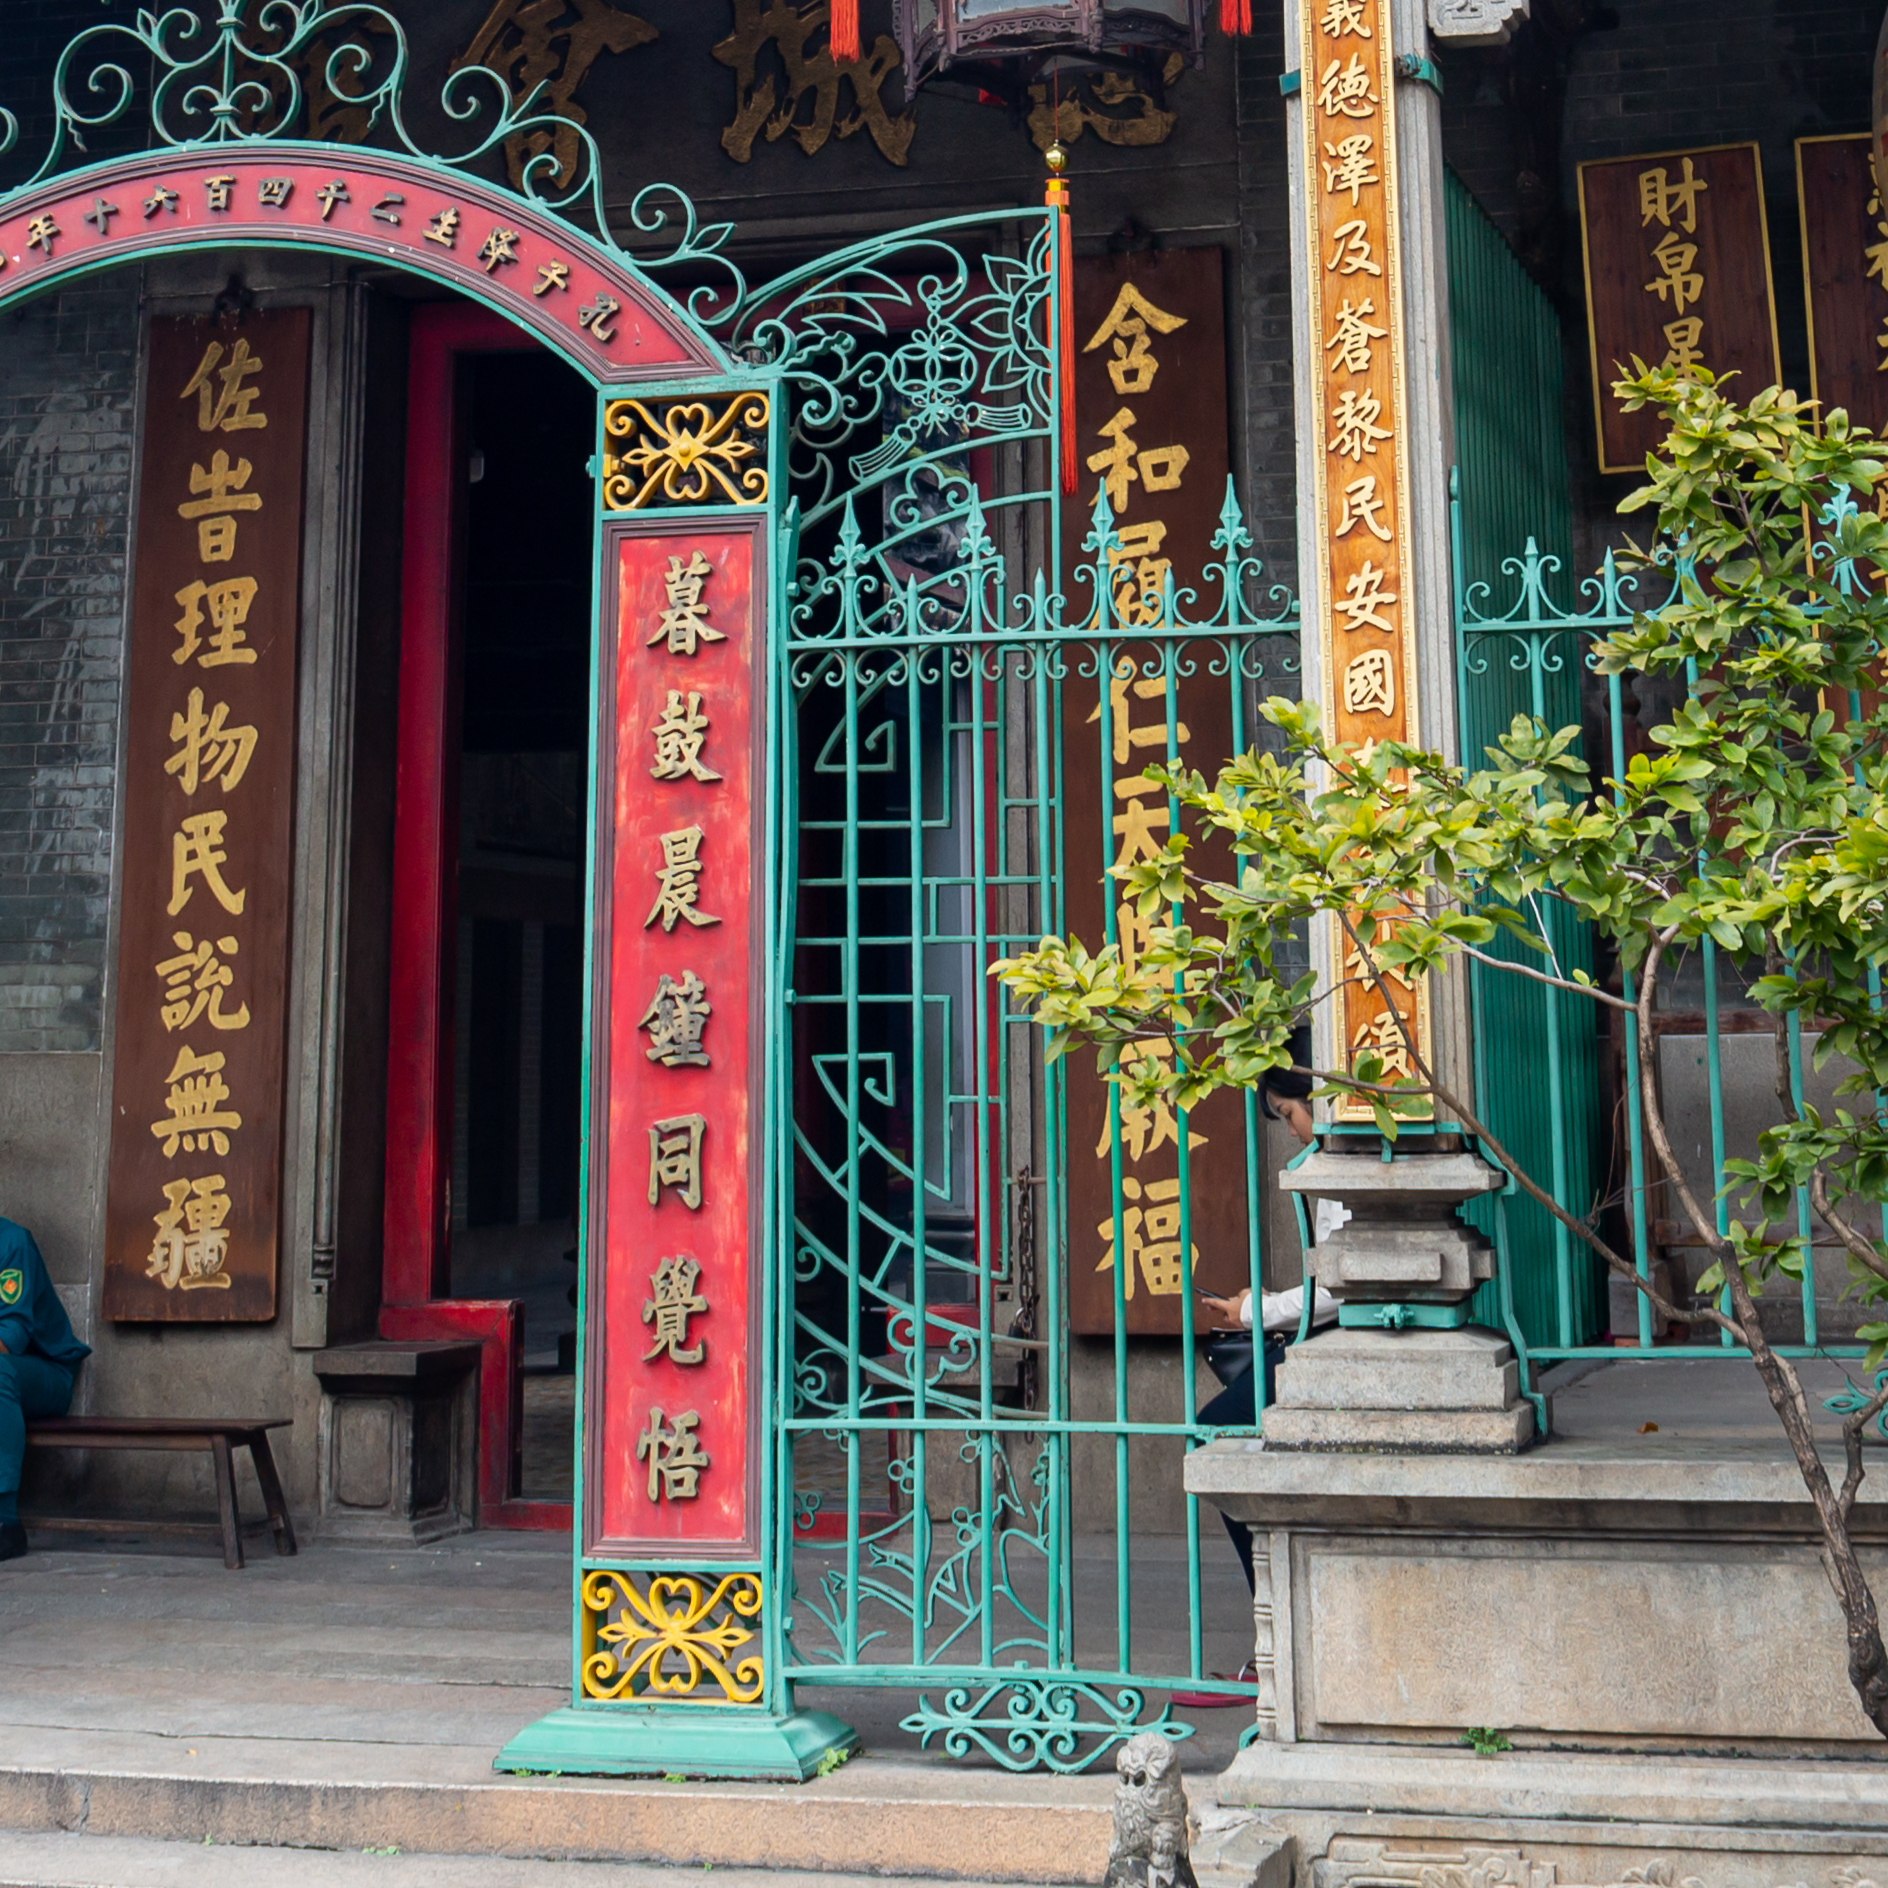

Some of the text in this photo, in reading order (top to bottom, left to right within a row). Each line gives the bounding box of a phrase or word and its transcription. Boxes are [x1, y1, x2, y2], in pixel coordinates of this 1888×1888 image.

[1638, 156, 1708, 412] 財帛星
[635, 552, 728, 1505] 暮鼓晨鐘同覺悟
